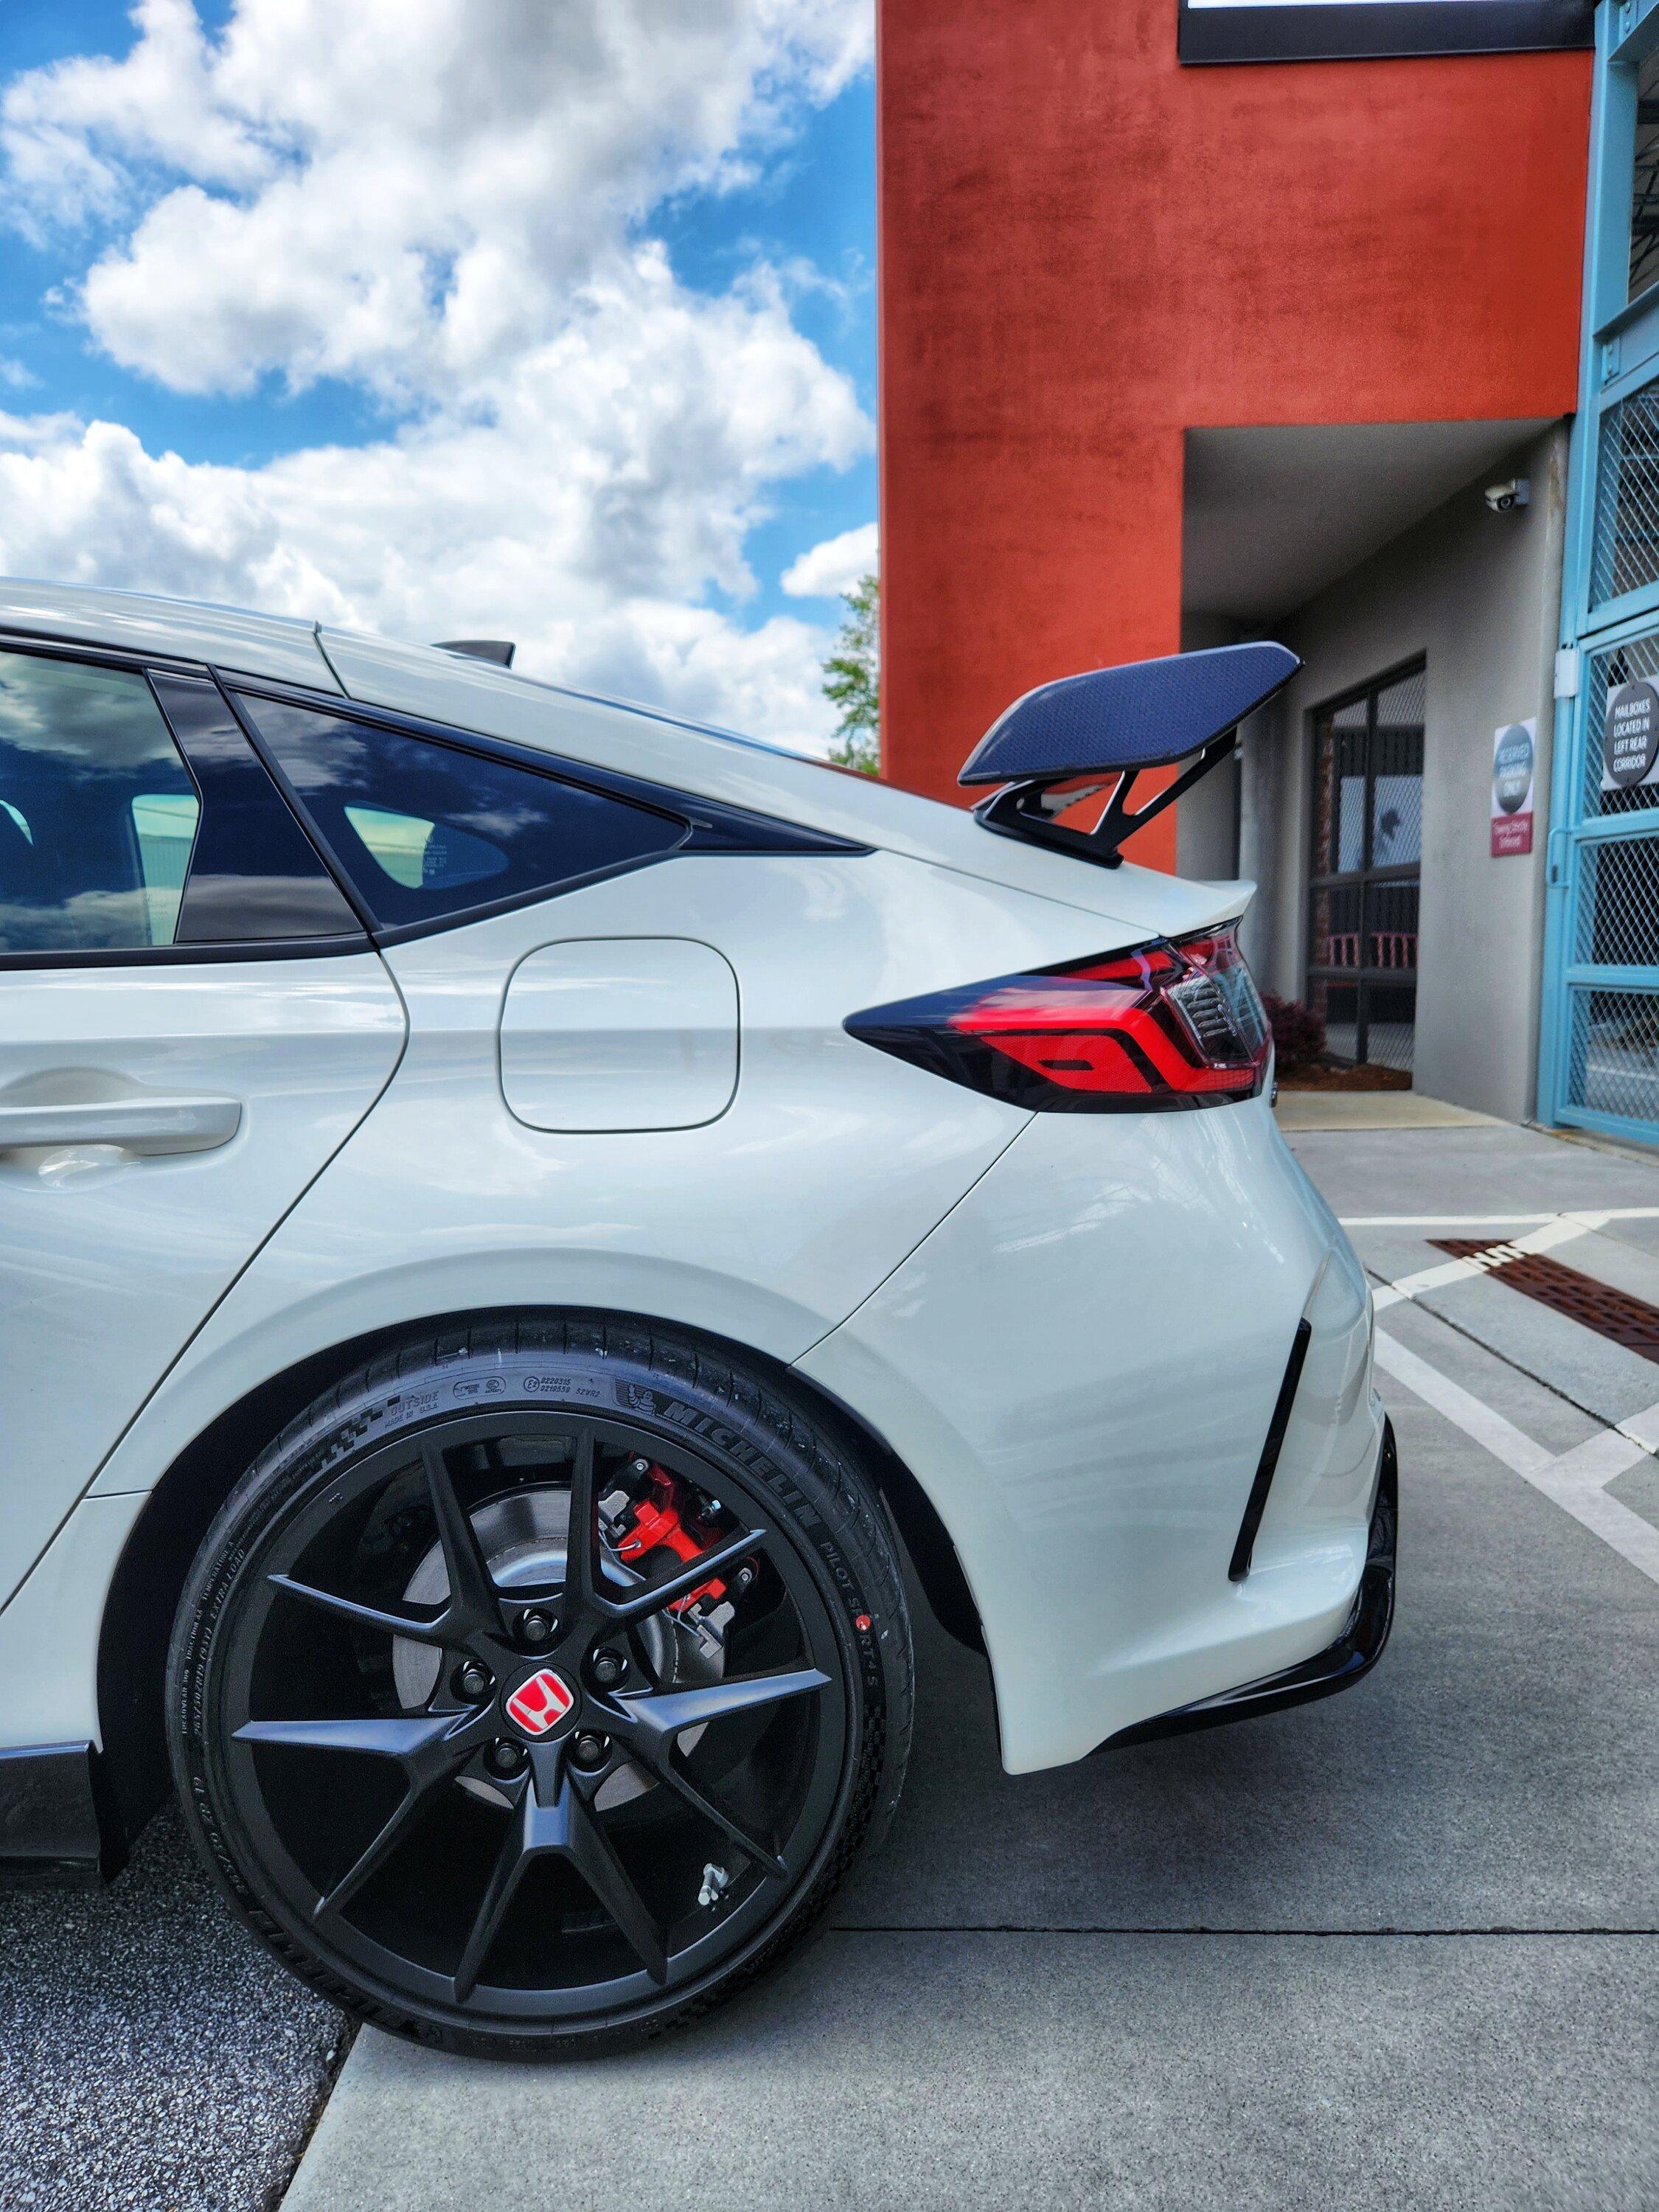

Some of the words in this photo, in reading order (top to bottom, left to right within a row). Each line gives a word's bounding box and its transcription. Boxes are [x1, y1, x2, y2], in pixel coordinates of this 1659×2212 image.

[1615, 698, 1651, 720] MAILBOXES
[1613, 718, 1641, 738] LOCATED
[1641, 717, 1650, 731] IN
[1614, 739, 1629, 755] LEFT
[1630, 735, 1647, 751] REAR
[1613, 754, 1646, 772] CORRIDOR
[391, 1392, 439, 1416] OUTSIDE
[664, 1401, 821, 1528] MICHELIN
[201, 1549, 229, 1601] TEMPERATURE
[820, 1541, 852, 1588] PILOT
[210, 1582, 229, 1619] EXTRA
[226, 1549, 246, 1579] LOAD
